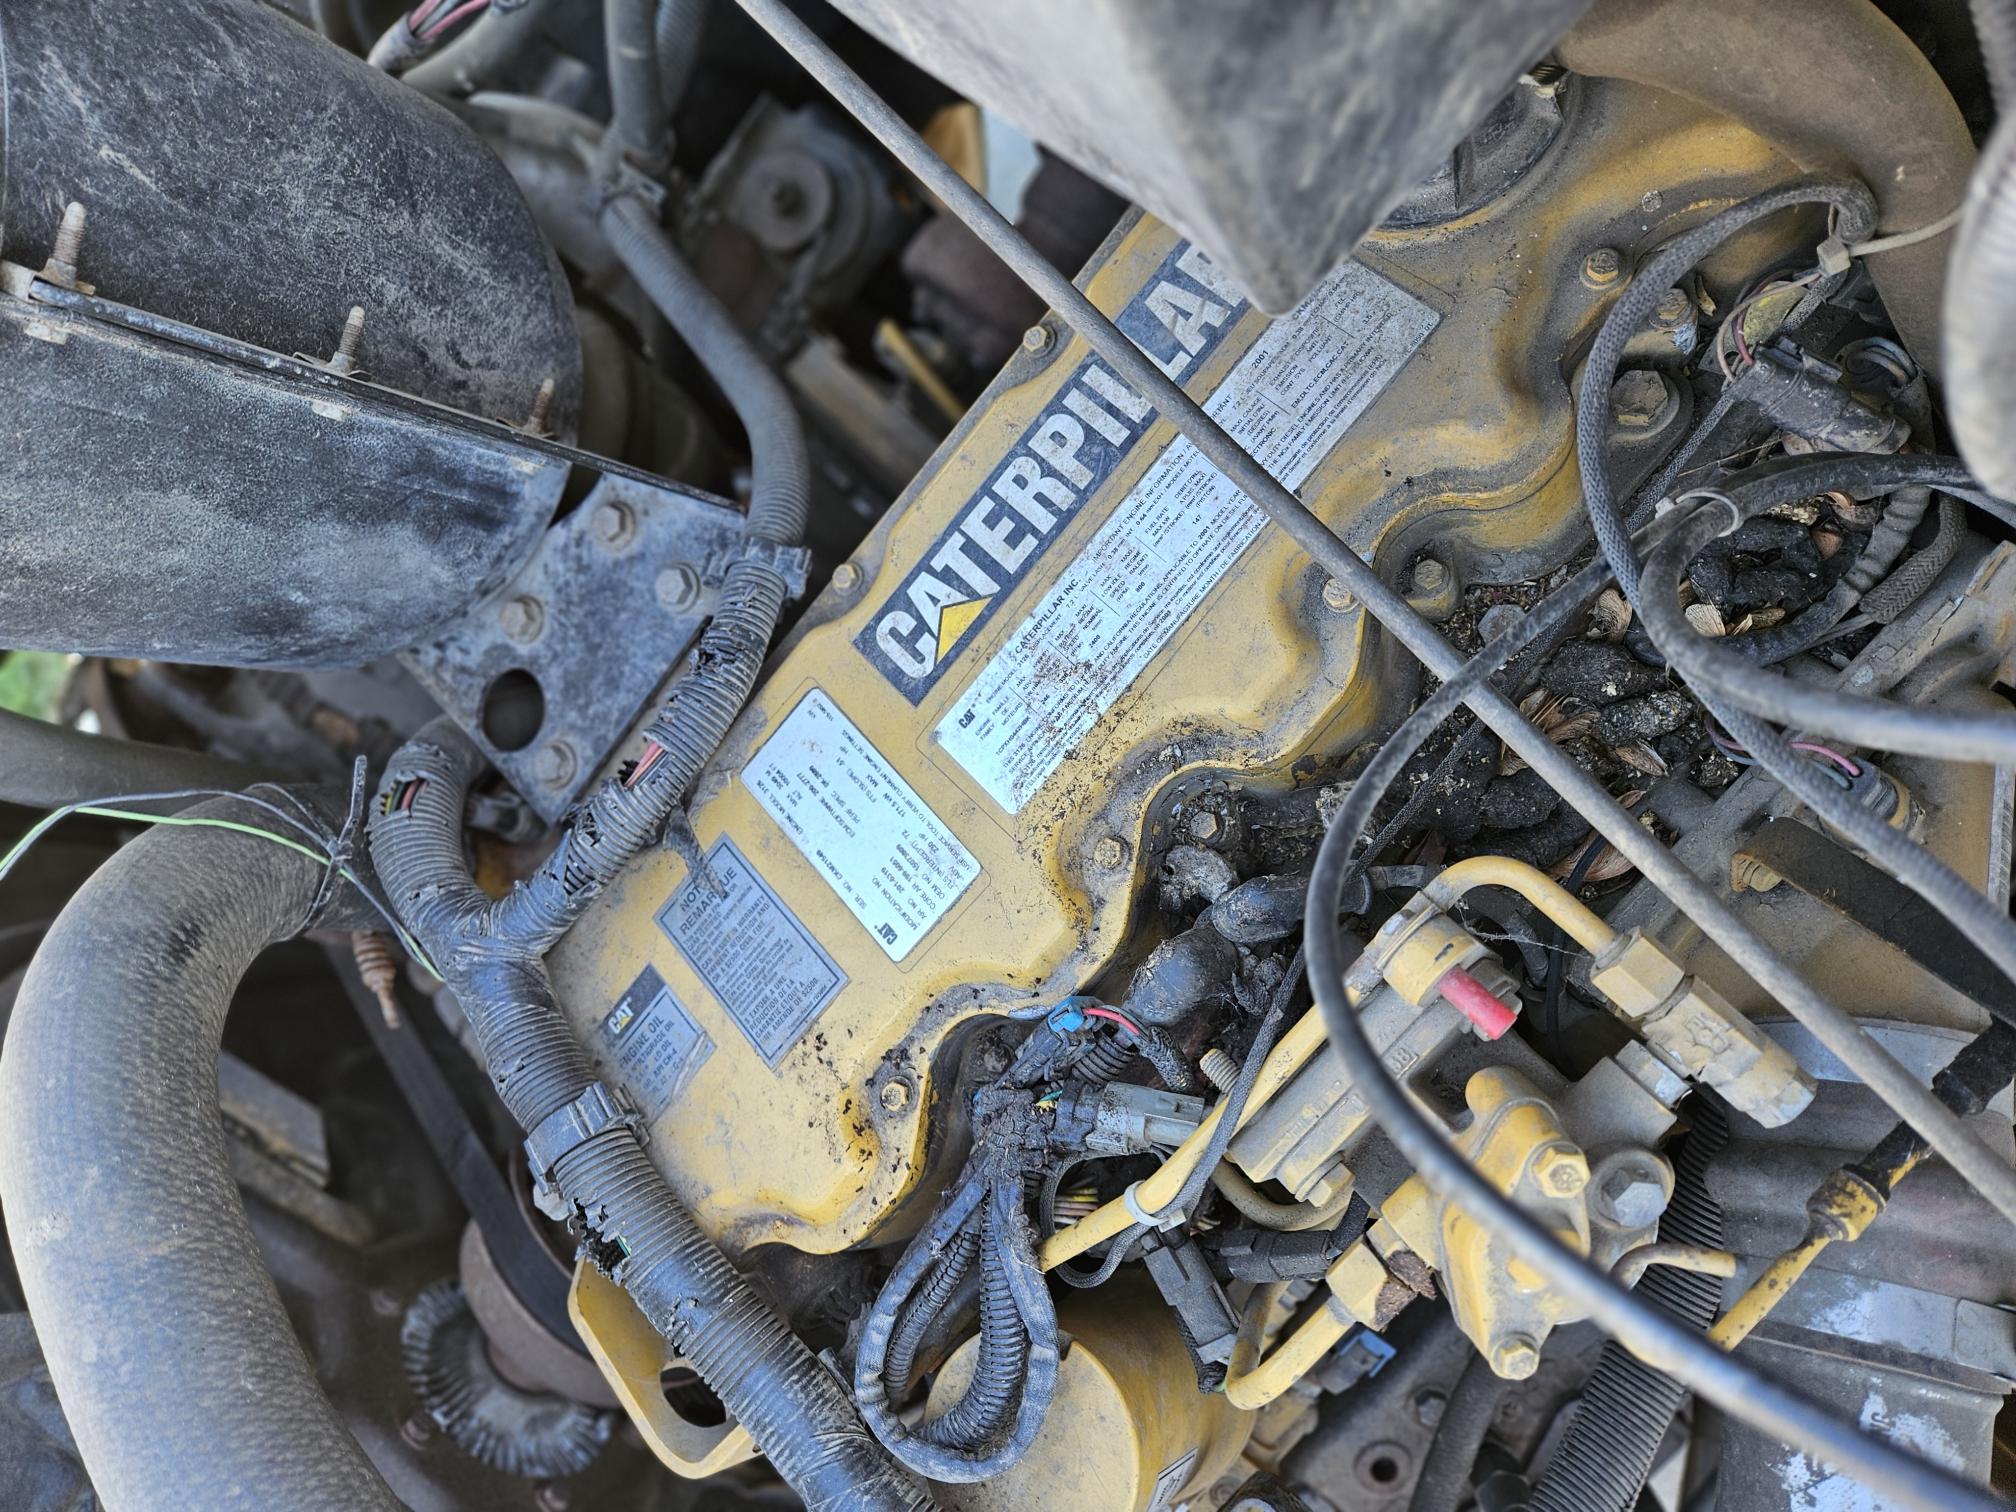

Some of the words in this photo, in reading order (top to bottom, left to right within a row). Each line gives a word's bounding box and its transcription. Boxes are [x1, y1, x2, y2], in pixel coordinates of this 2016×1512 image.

[1250, 349, 1269, 369] 2001
[1249, 426, 1277, 457] ECTRONIC
[1266, 441, 1281, 458] DUTY
[1279, 422, 1298, 442] DIESEL
[1122, 497, 1146, 524] ENGINE
[1143, 452, 1184, 499] INFORMATION
[1192, 513, 1202, 525] 147
[1197, 525, 1210, 539] 2001
[1209, 504, 1228, 525] MODEL
[1226, 489, 1241, 506] YEAR
[1198, 570, 1219, 593] MONTH
[1012, 593, 1066, 655] CATERPILLAR
[865, 773, 878, 787] MAX
[890, 800, 906, 817] 171.5
[900, 793, 920, 815] VERIFY
[924, 819, 939, 836] TOOL
[927, 840, 939, 853] 230
[938, 834, 960, 858] SERVICE
[679, 866, 737, 936] REMARUE
[880, 887, 919, 931] MODIFICATION
[919, 890, 937, 910] CORE
[876, 920, 898, 946] CAT
[645, 1012, 665, 1035] OIL
[771, 1004, 795, 1032] AMENDE
